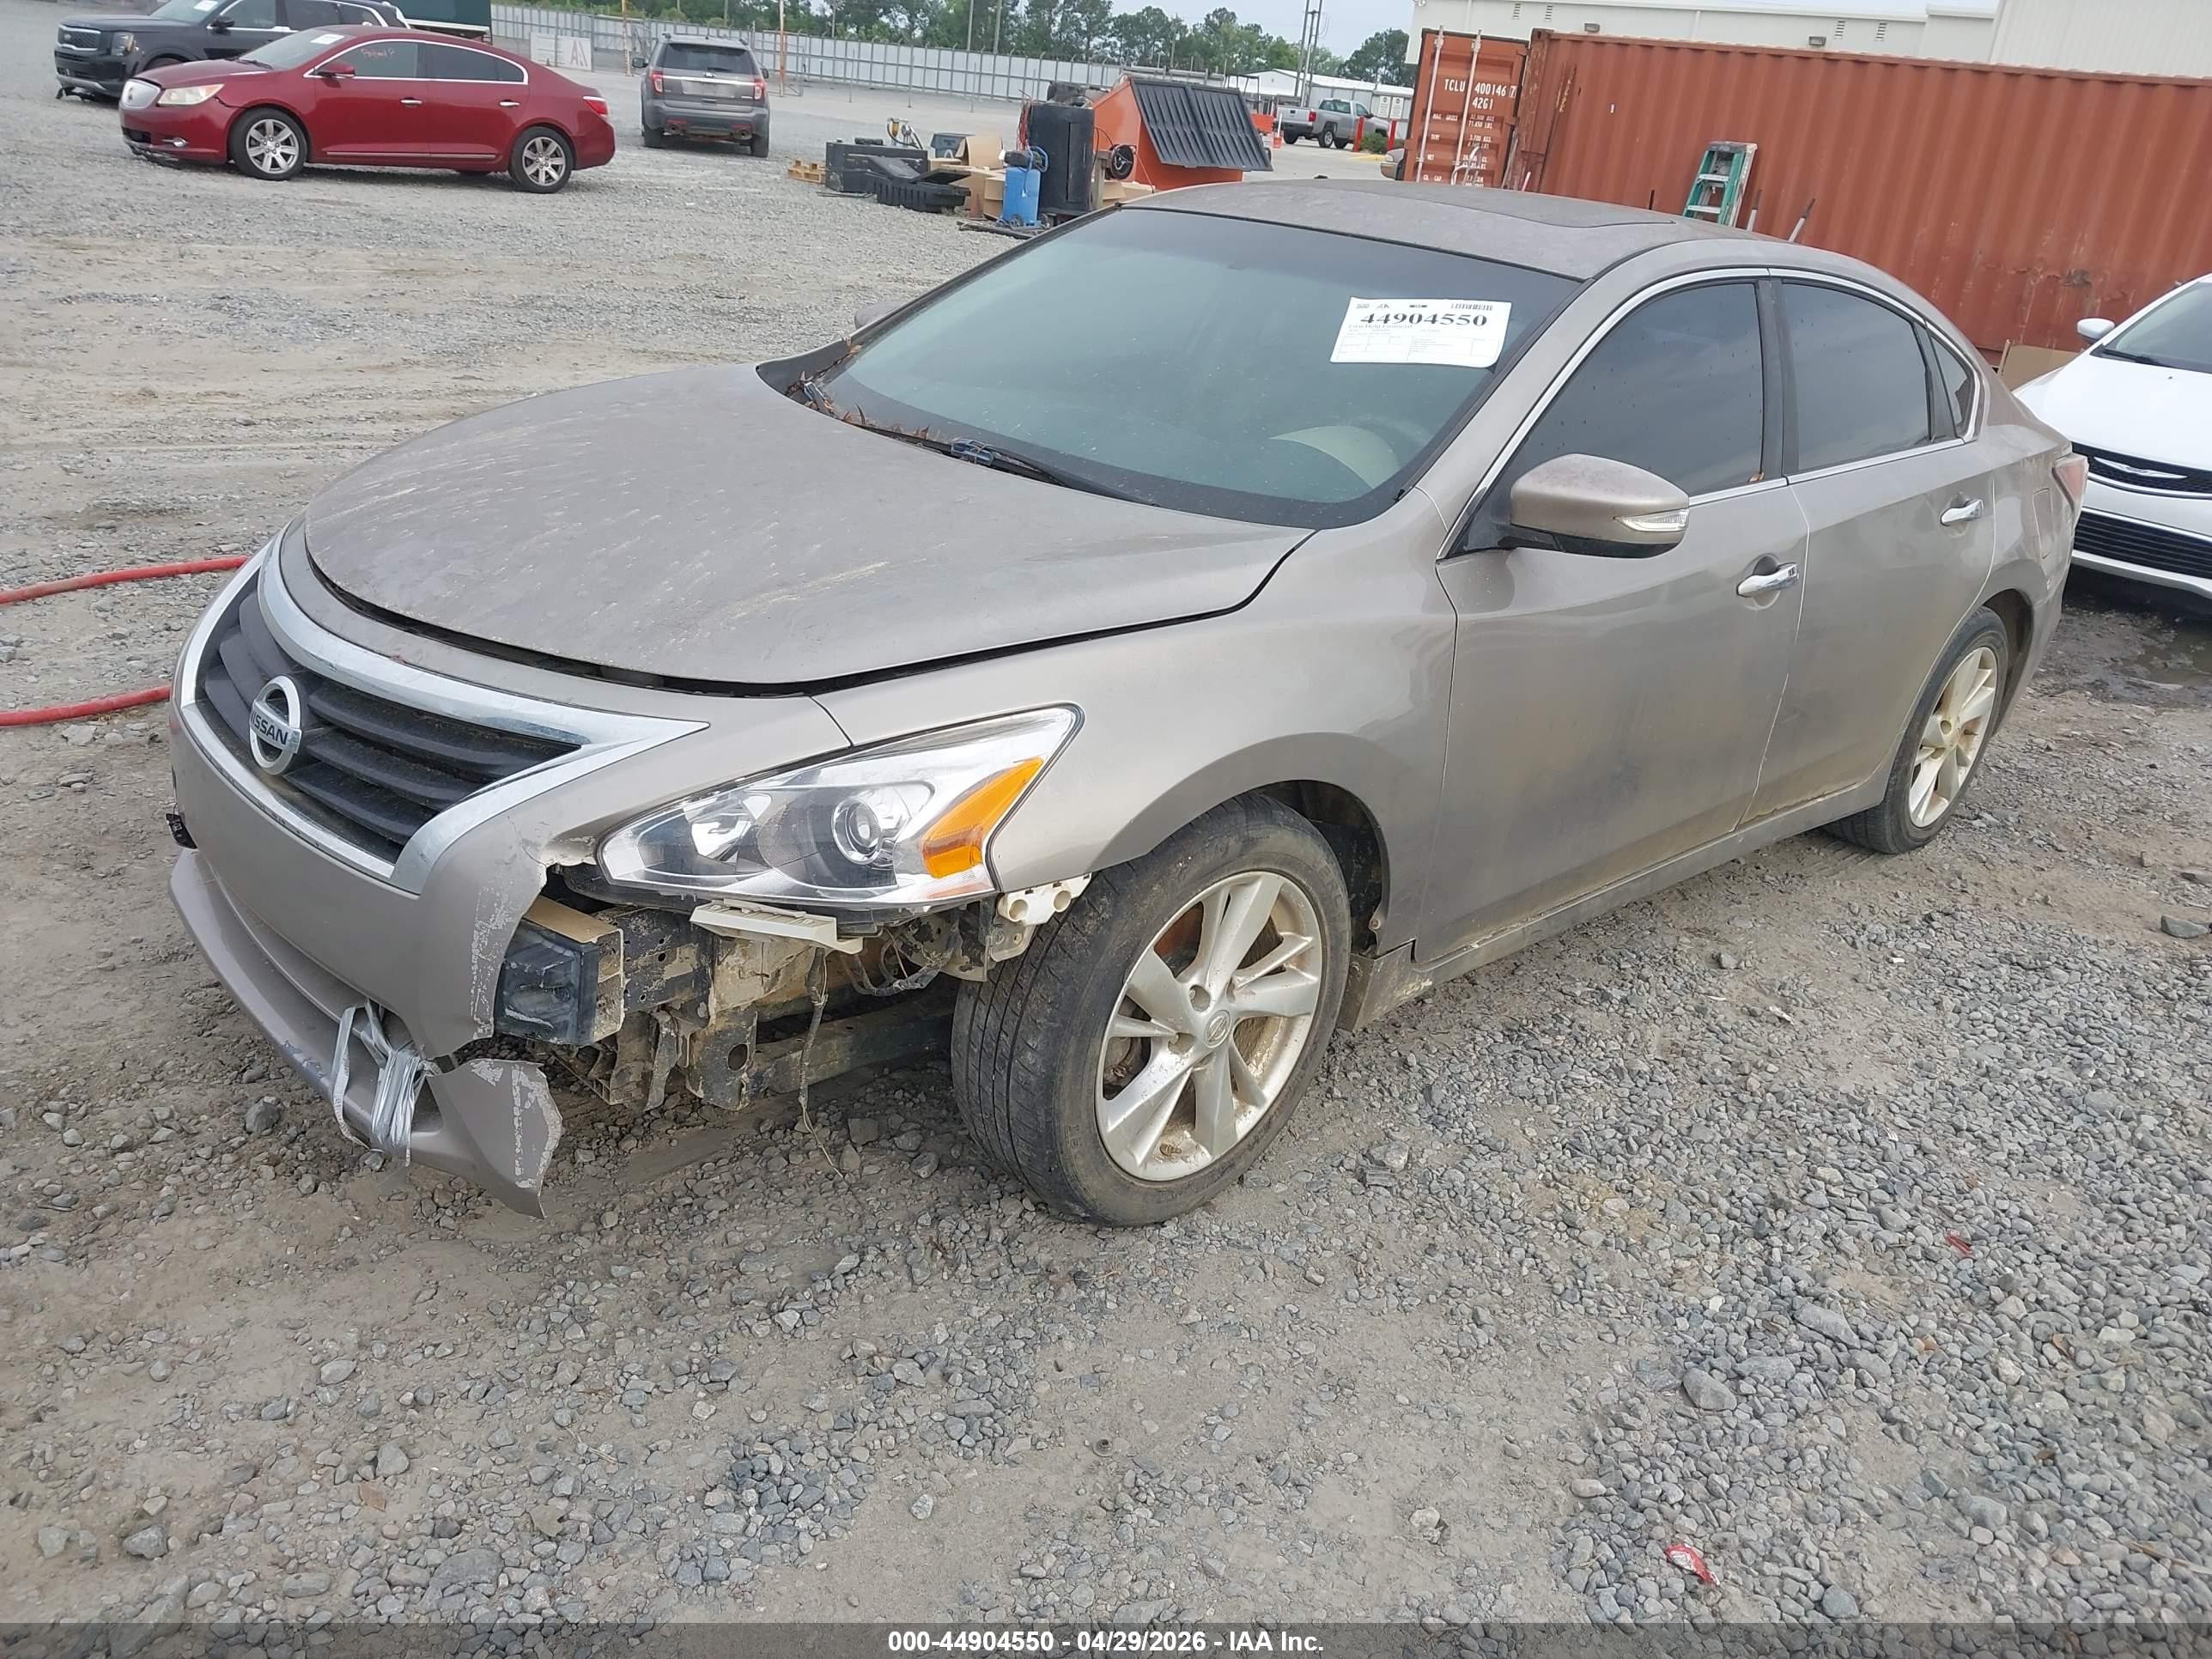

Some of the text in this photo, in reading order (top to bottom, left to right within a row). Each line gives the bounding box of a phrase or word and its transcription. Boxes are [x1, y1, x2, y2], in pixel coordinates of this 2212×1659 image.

[1444, 79, 1466, 92] TCLU
[1474, 82, 1507, 97] 400146
[1472, 96, 1493, 110] 42G1
[1360, 313, 1487, 327] 44904550
